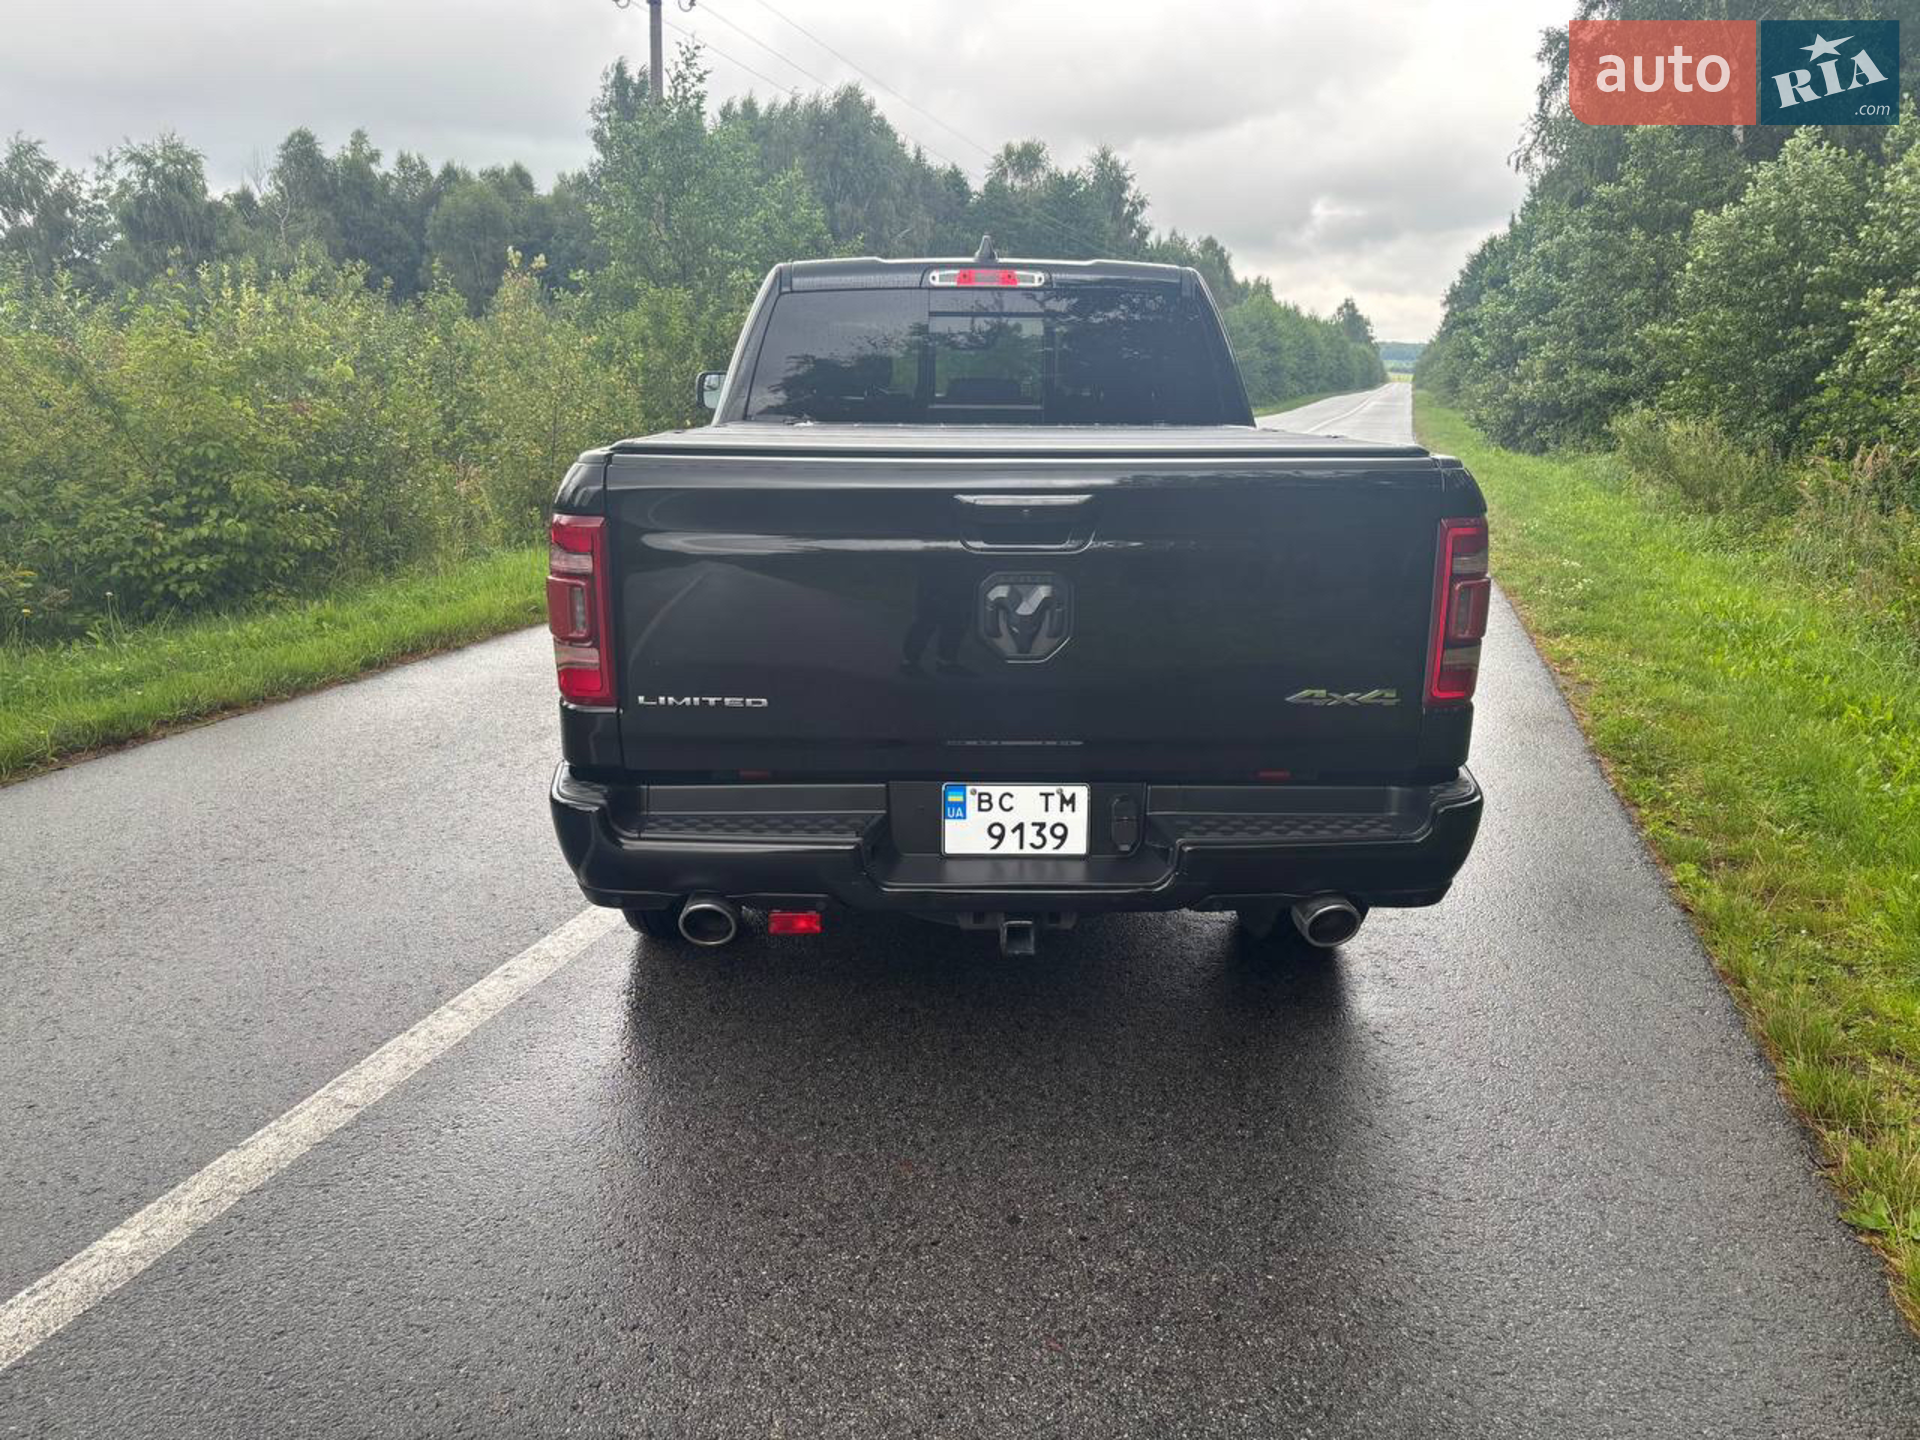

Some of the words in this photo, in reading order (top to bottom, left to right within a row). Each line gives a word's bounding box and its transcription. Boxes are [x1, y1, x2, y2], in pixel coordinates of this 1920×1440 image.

[637, 694, 769, 708] LIMITED
[977, 791, 1015, 813] BC
[1039, 791, 1076, 813] TM
[947, 806, 964, 819] UA
[986, 821, 1069, 850] 9139
